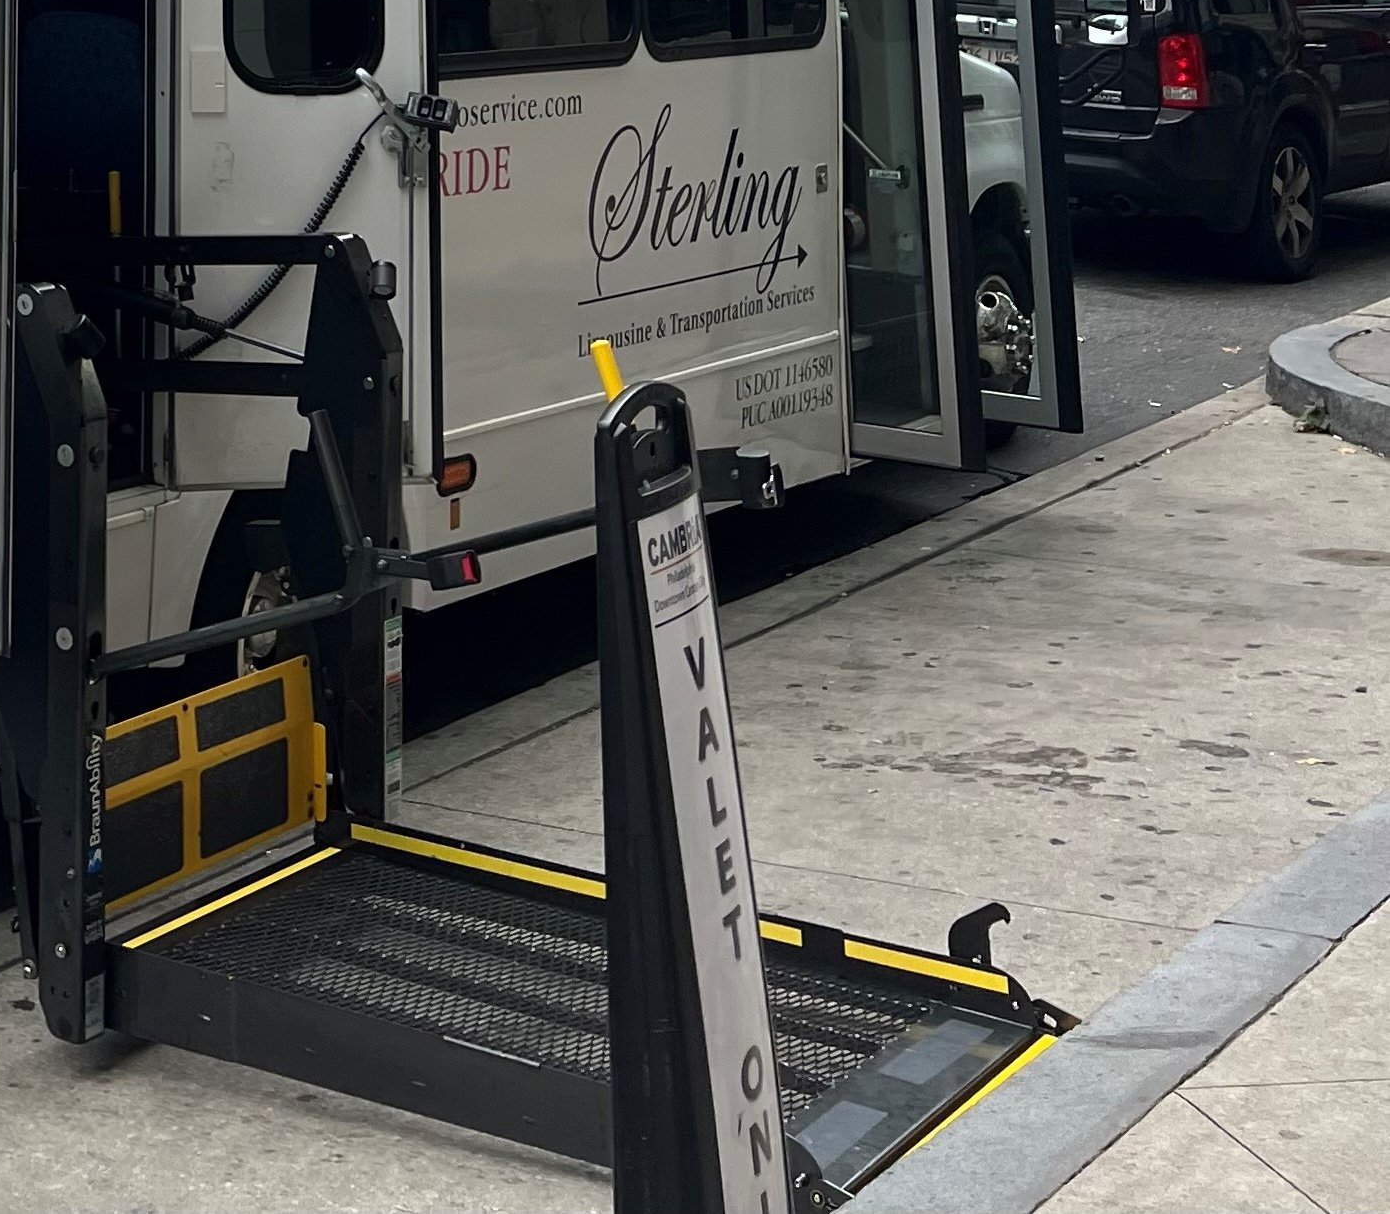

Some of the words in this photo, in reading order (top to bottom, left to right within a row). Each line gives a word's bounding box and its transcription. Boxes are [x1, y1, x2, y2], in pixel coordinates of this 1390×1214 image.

[588, 103, 803, 296] Sterling
[656, 317, 666, 337] &
[669, 296, 763, 335] Transportation
[766, 285, 815, 312] Services
[741, 400, 767, 429] PUC
[754, 368, 781, 395] DOT
[86, 734, 104, 847] BraunAbility
[683, 636, 742, 961] VALET
